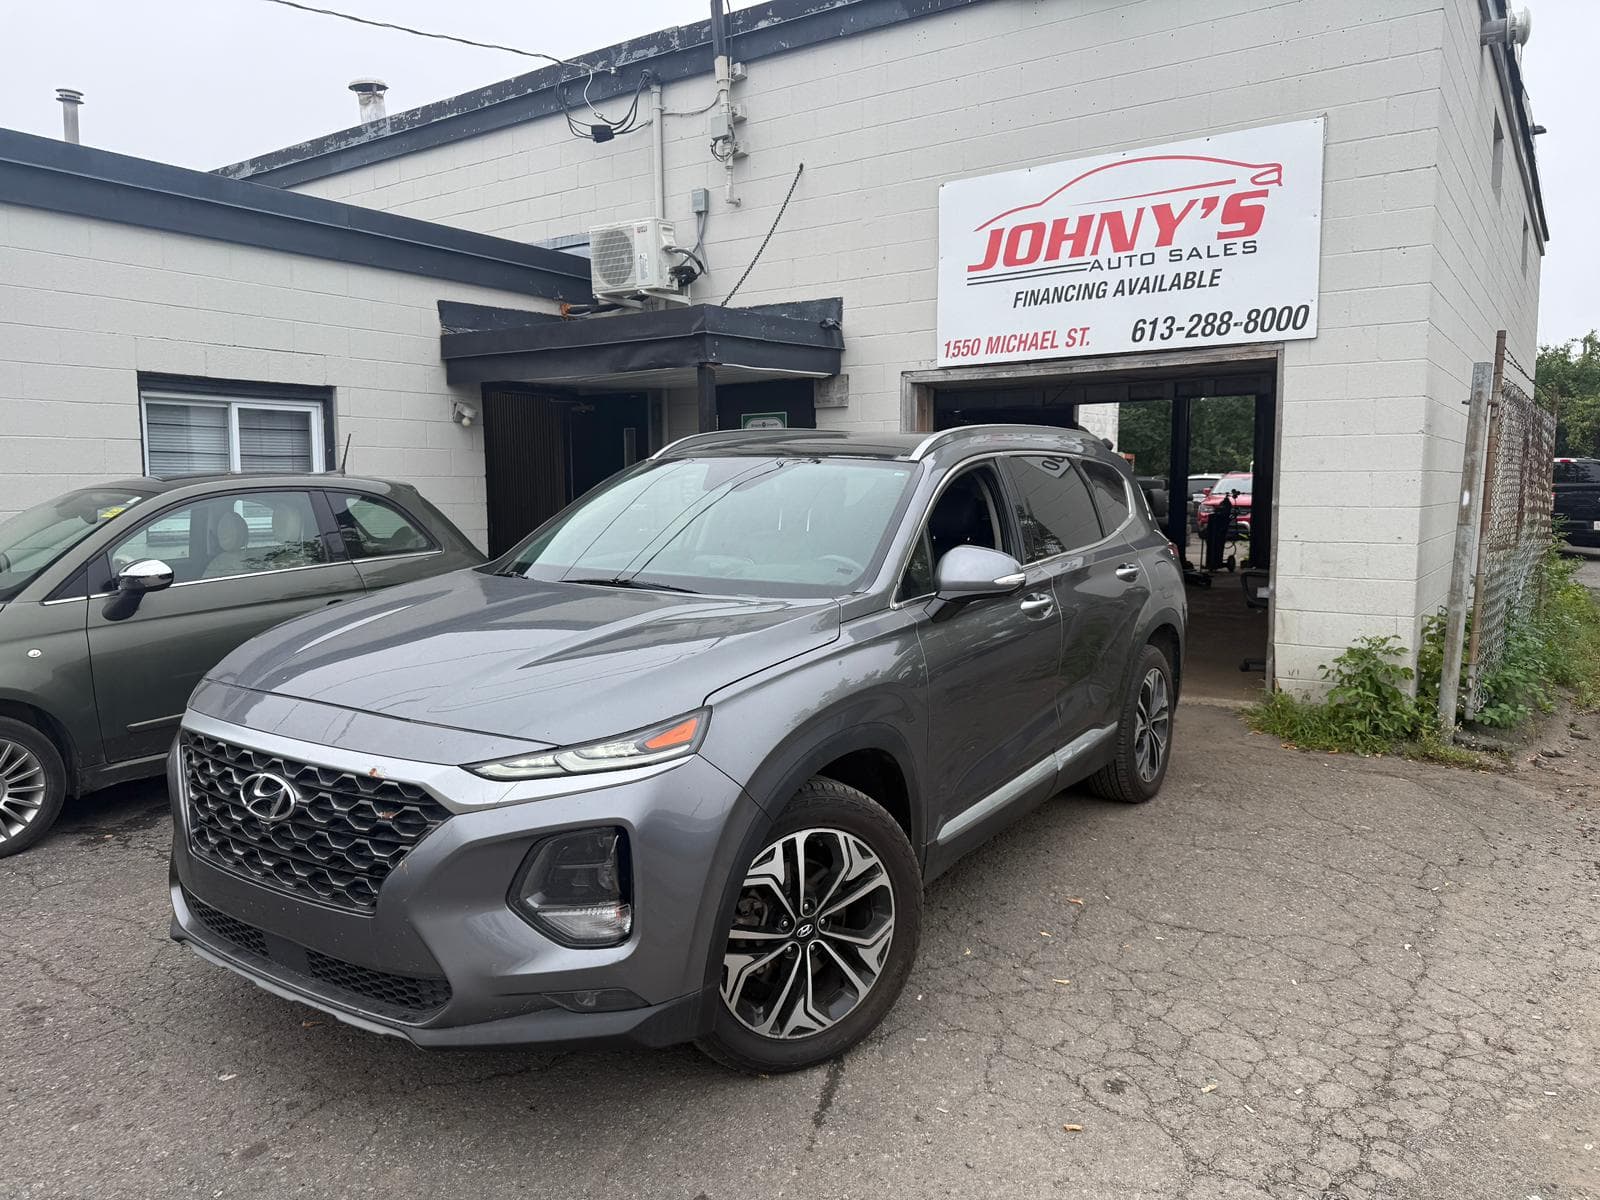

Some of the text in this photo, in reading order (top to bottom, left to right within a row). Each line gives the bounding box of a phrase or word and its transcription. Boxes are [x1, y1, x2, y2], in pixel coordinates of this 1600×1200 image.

[967, 189, 1269, 273] JOHNY'S
[1089, 240, 1258, 273] AUTO SALES
[1013, 268, 1222, 309] FINANCING AVAILABLE
[944, 326, 1091, 359] 1550 MICHAEL ST.
[1131, 304, 1310, 343] 613-288-8000
